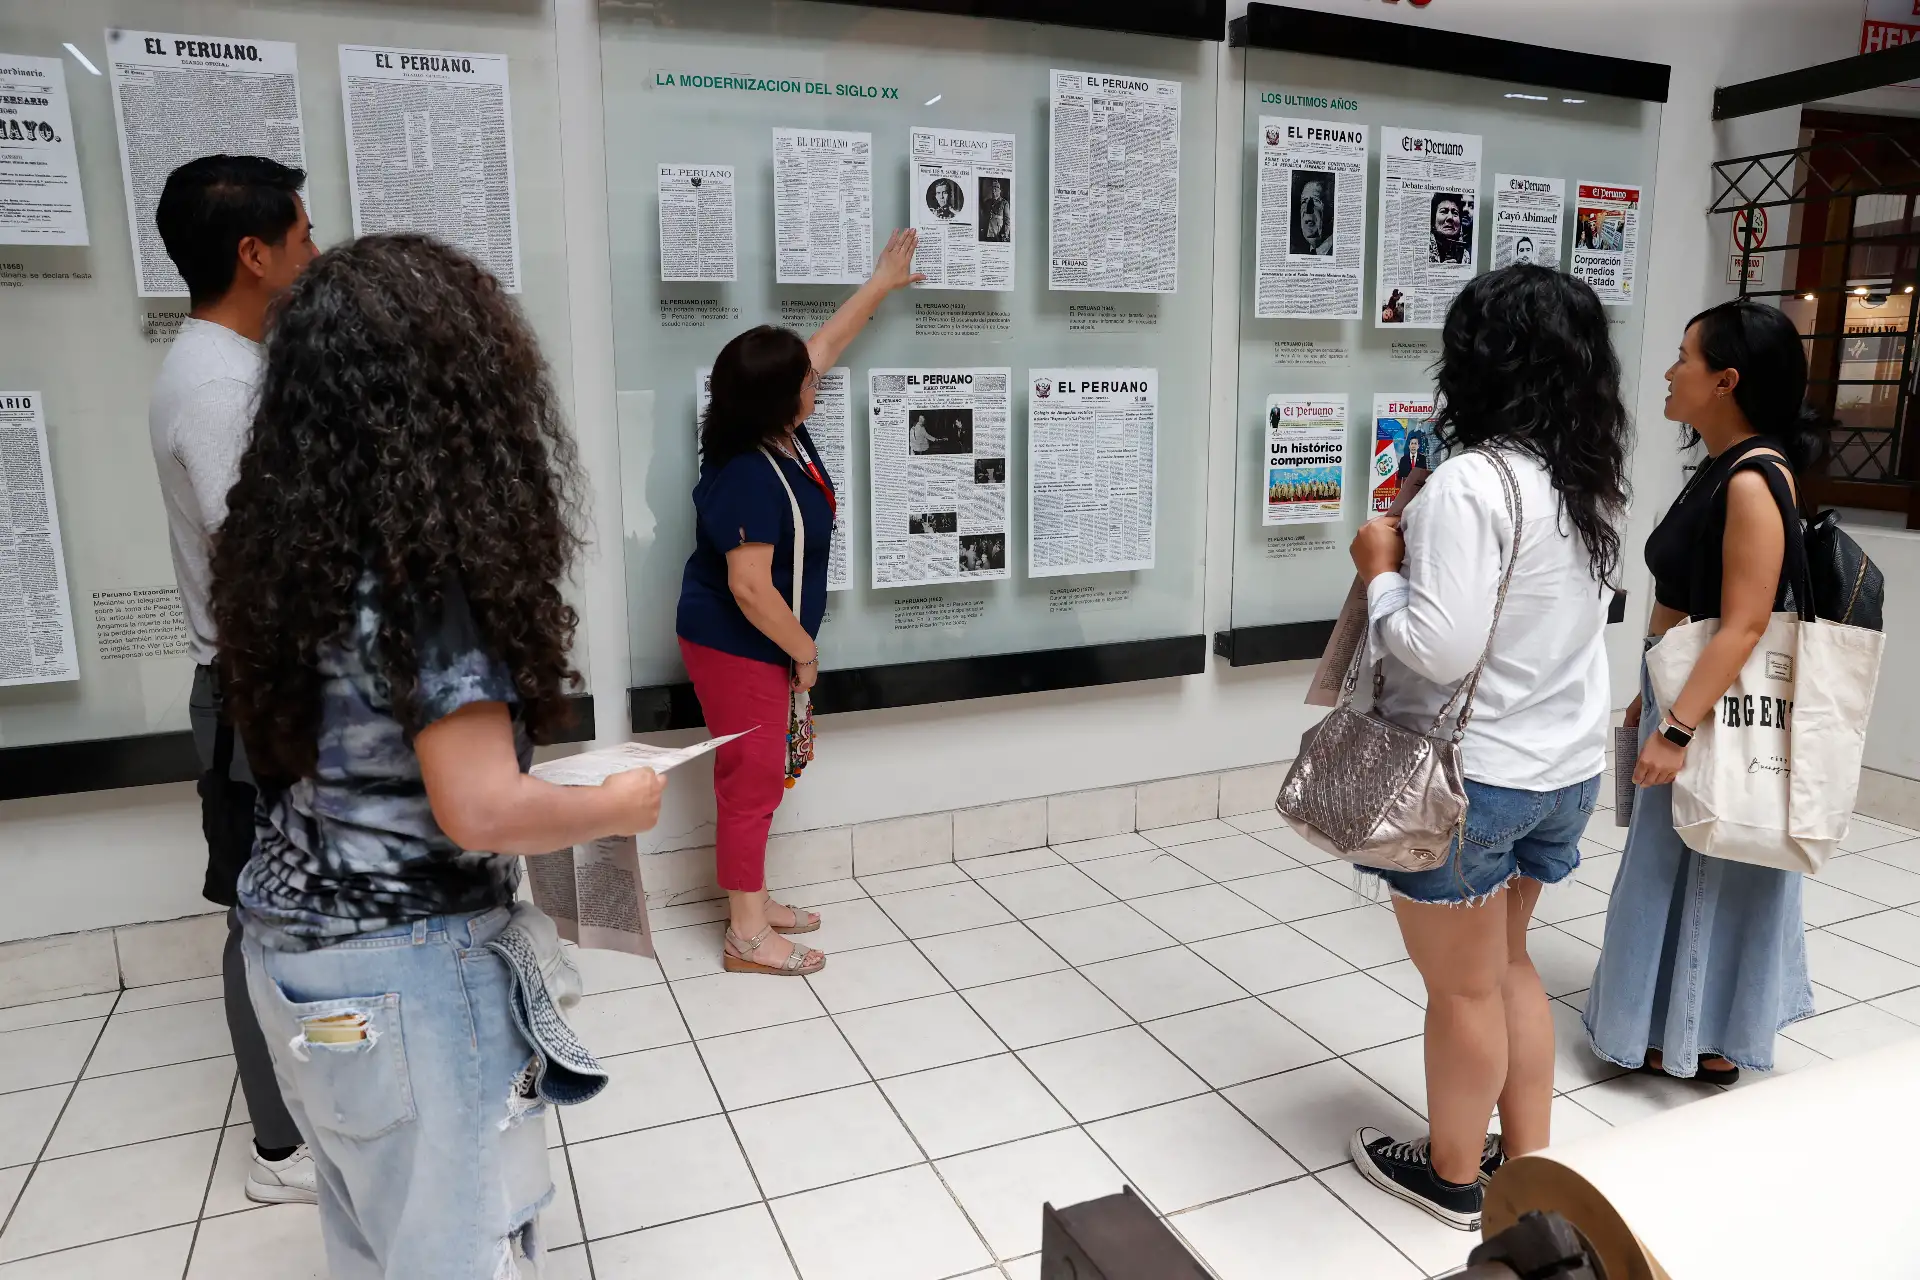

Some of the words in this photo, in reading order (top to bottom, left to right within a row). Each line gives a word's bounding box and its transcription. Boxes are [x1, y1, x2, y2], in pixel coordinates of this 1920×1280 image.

[144, 38, 166, 55] EL
[174, 40, 262, 62] PERUANO.
[376, 54, 393, 68] EL
[400, 56, 475, 73] PERUANO.
[656, 74, 675, 86] LA
[680, 74, 800, 93] MODERNIZACION
[805, 82, 832, 95] DEL
[836, 84, 877, 98] SIGLO
[882, 88, 899, 99] XX
[1087, 77, 1099, 86] EL
[1102, 78, 1149, 92] PERUANO
[1262, 92, 1282, 104] LOS
[1284, 94, 1328, 108] ULTIMOS
[1330, 97, 1358, 111] AÑOS
[1288, 126, 1303, 138] EL
[1308, 128, 1362, 143] PERUANO
[797, 137, 807, 146] EL
[810, 138, 847, 148] PERUANO
[950, 139, 988, 149] PERUANO
[1401, 136, 1413, 151] El
[1424, 138, 1464, 156] Peruano
[678, 169, 732, 178] PERUANO
[1402, 182, 1423, 190] Debate
[1424, 183, 1444, 191] abierto
[1510, 179, 1517, 190] El
[1524, 180, 1550, 192] Peruano
[1592, 188, 1600, 196] El
[1601, 188, 1626, 199] Peruano
[1498, 210, 1520, 223] ¡Cayó
[1574, 255, 1621, 266] Corporación
[1574, 266, 1583, 274] de
[1586, 267, 1614, 276] medios
[1588, 277, 1615, 286] Estado
[907, 375, 920, 385] EL
[923, 374, 973, 384] PERUANO
[1058, 382, 1076, 393] EL
[1081, 381, 1148, 393] PERUANO
[1284, 406, 1294, 416] El
[1296, 407, 1333, 418] Peruano
[1389, 403, 1397, 412] El
[1399, 404, 1433, 412] Peruano
[1271, 444, 1287, 453] Un
[1292, 442, 1342, 453] histórico
[1271, 454, 1342, 467] compromiso
